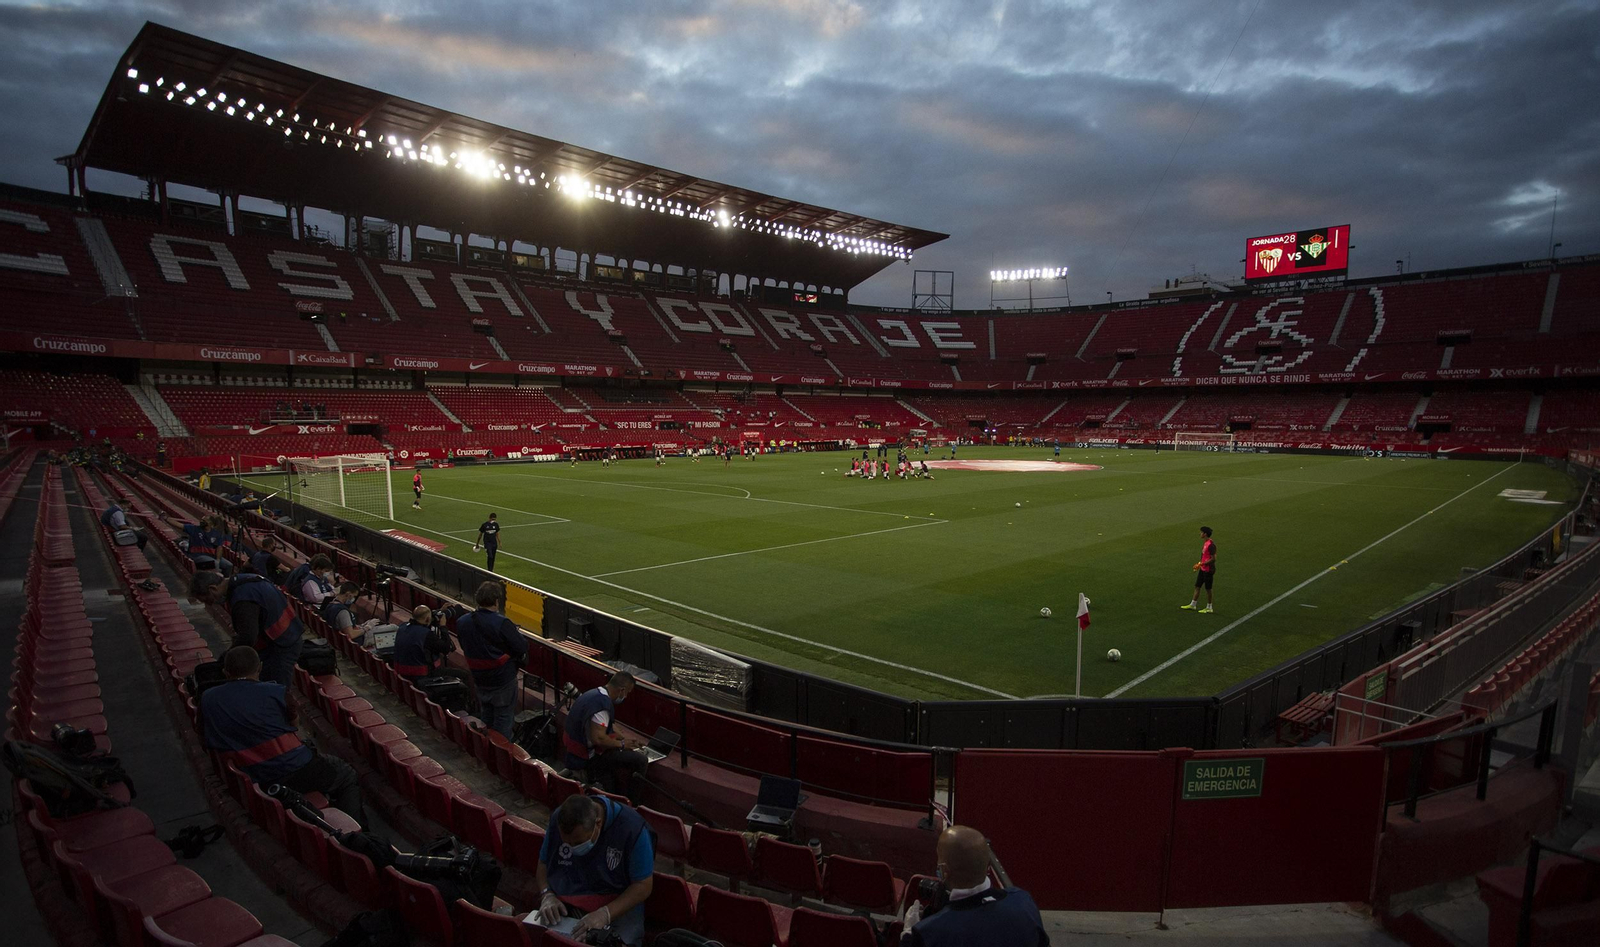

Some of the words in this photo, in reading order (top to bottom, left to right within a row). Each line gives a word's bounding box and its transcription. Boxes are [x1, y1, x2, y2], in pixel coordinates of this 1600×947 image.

[565, 290, 615, 331] Y
[656, 296, 976, 349] CORAJE
[34, 337, 106, 354] Cruzcampo
[201, 348, 261, 361] Cruzcampo
[309, 354, 348, 364] CaixaBank
[394, 358, 439, 368] Cruzcampo
[519, 364, 556, 373] Cruzcampo
[1506, 367, 1540, 376] everfx
[726, 373, 753, 381] Cruzcampo
[801, 376, 825, 384] Cruzcampo
[1239, 376, 1268, 384] NUNCA
[1270, 375, 1280, 383] SE
[1283, 374, 1310, 382] RINDE
[310, 425, 336, 433] everfx
[1196, 767, 1234, 779] SALIDA
[1237, 766, 1251, 777] DE
[1188, 779, 1257, 792] EMERGENCIA
